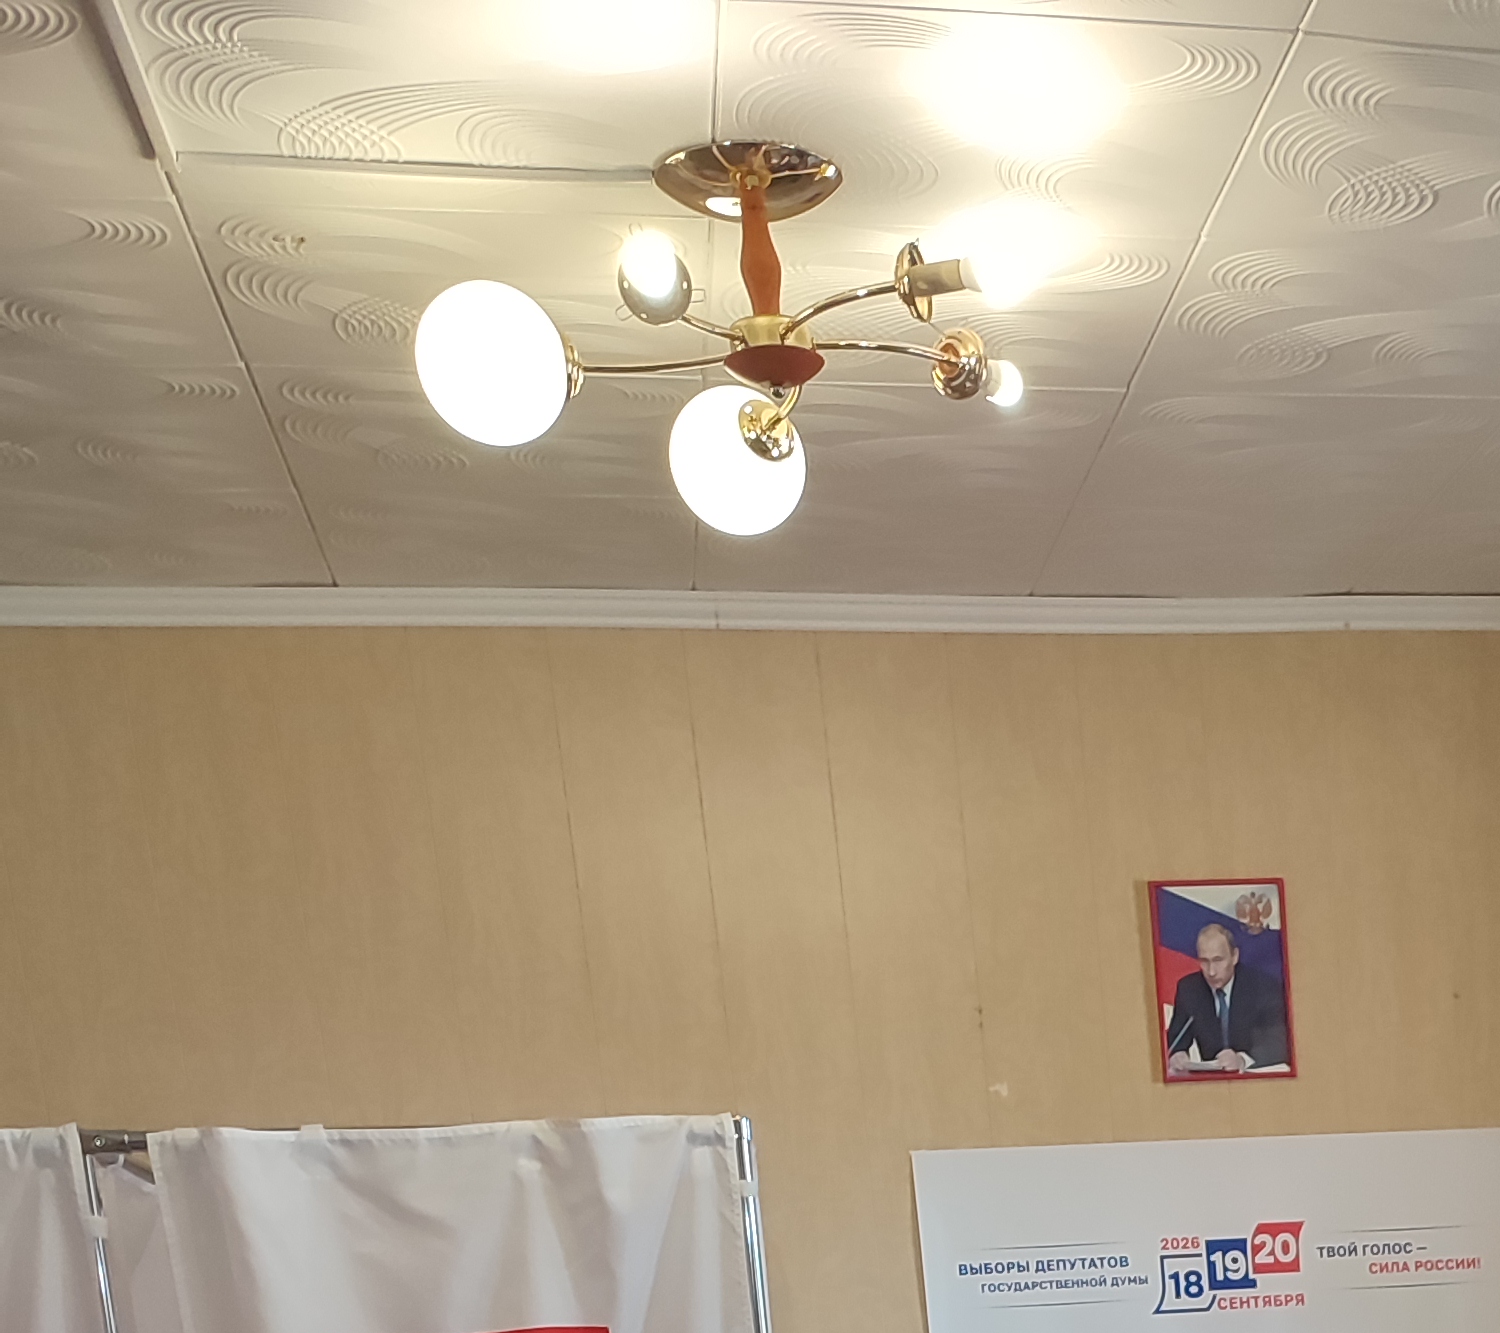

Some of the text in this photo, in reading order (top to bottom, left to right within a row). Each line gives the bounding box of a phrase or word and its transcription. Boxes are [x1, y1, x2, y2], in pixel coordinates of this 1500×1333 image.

[1160, 1237, 1200, 1250] 2026
[1316, 1241, 1358, 1258] ТВОЙ
[1362, 1242, 1413, 1256] ГОЛОС
[958, 1256, 1130, 1276] ВЫБОРЫ ДЕПУТАТОВ
[1168, 1233, 1297, 1299] 18 19 20
[1368, 1257, 1482, 1274] СИЛА РОССИИ!
[981, 1275, 1149, 1293] ГОСУДАРСТВЕННОЙ ДУМЫ
[1217, 1293, 1305, 1310] СЕНТЯБРЯ
